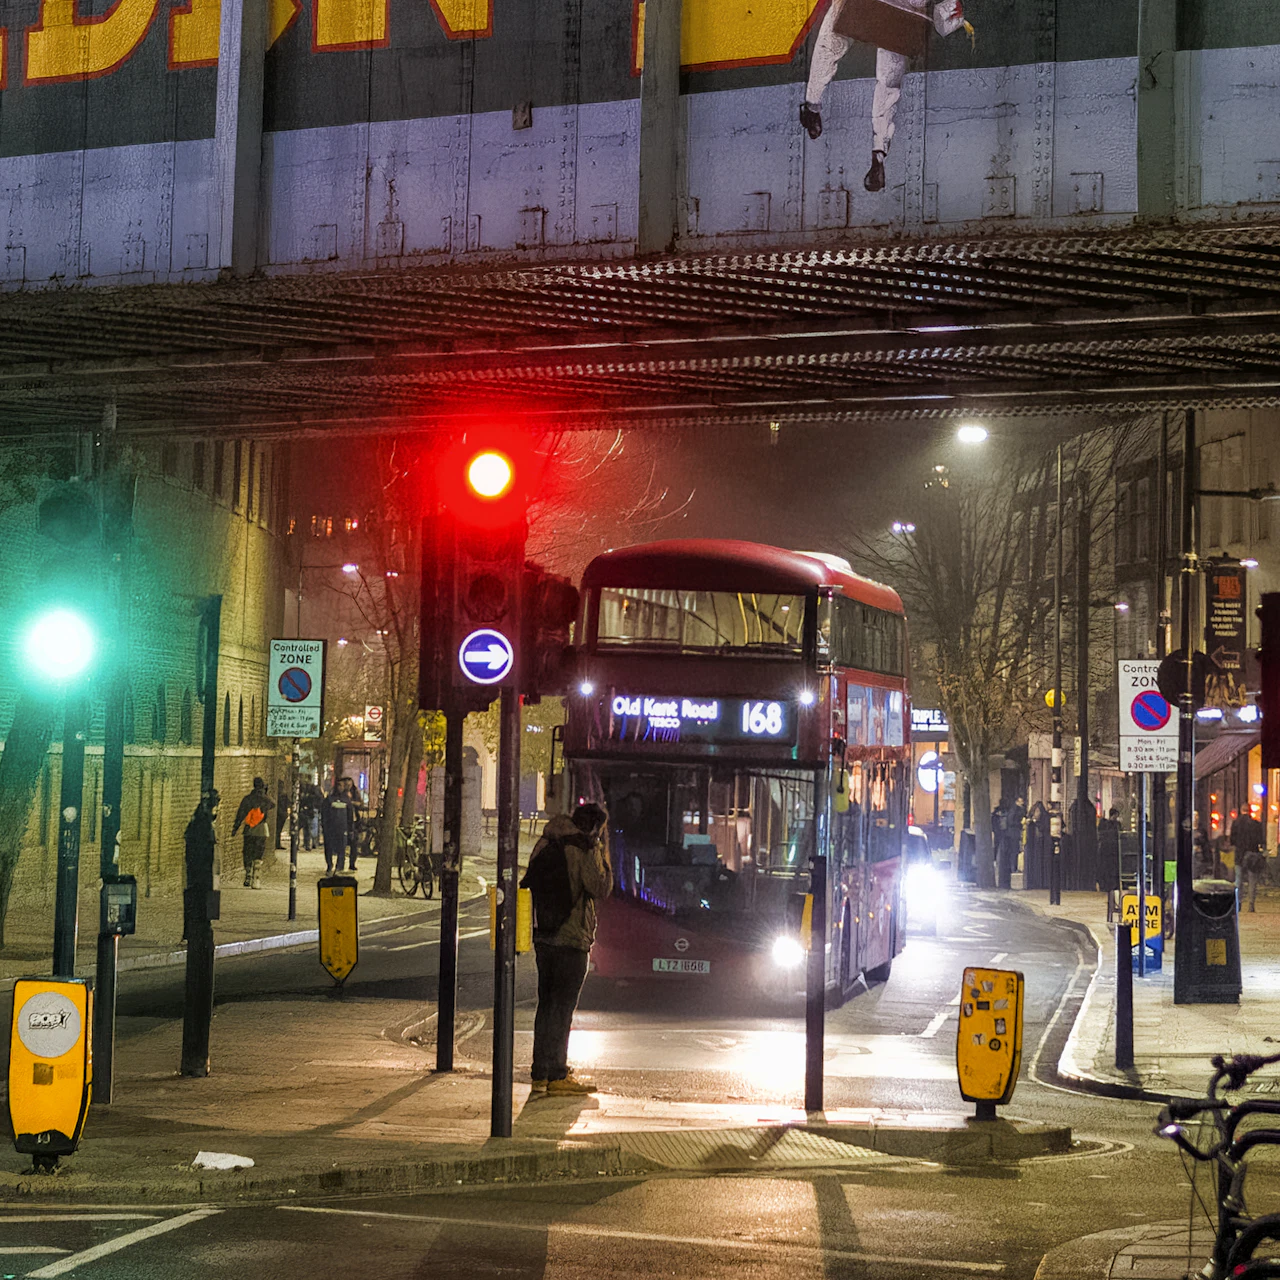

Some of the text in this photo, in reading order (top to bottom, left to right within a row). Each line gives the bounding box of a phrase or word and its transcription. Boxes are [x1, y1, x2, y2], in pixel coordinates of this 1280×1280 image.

[274, 643, 320, 652] Controlled
[280, 654, 313, 664] ZONE
[612, 695, 782, 734] Old Kent Road 168
[1126, 904, 1158, 916] AM
